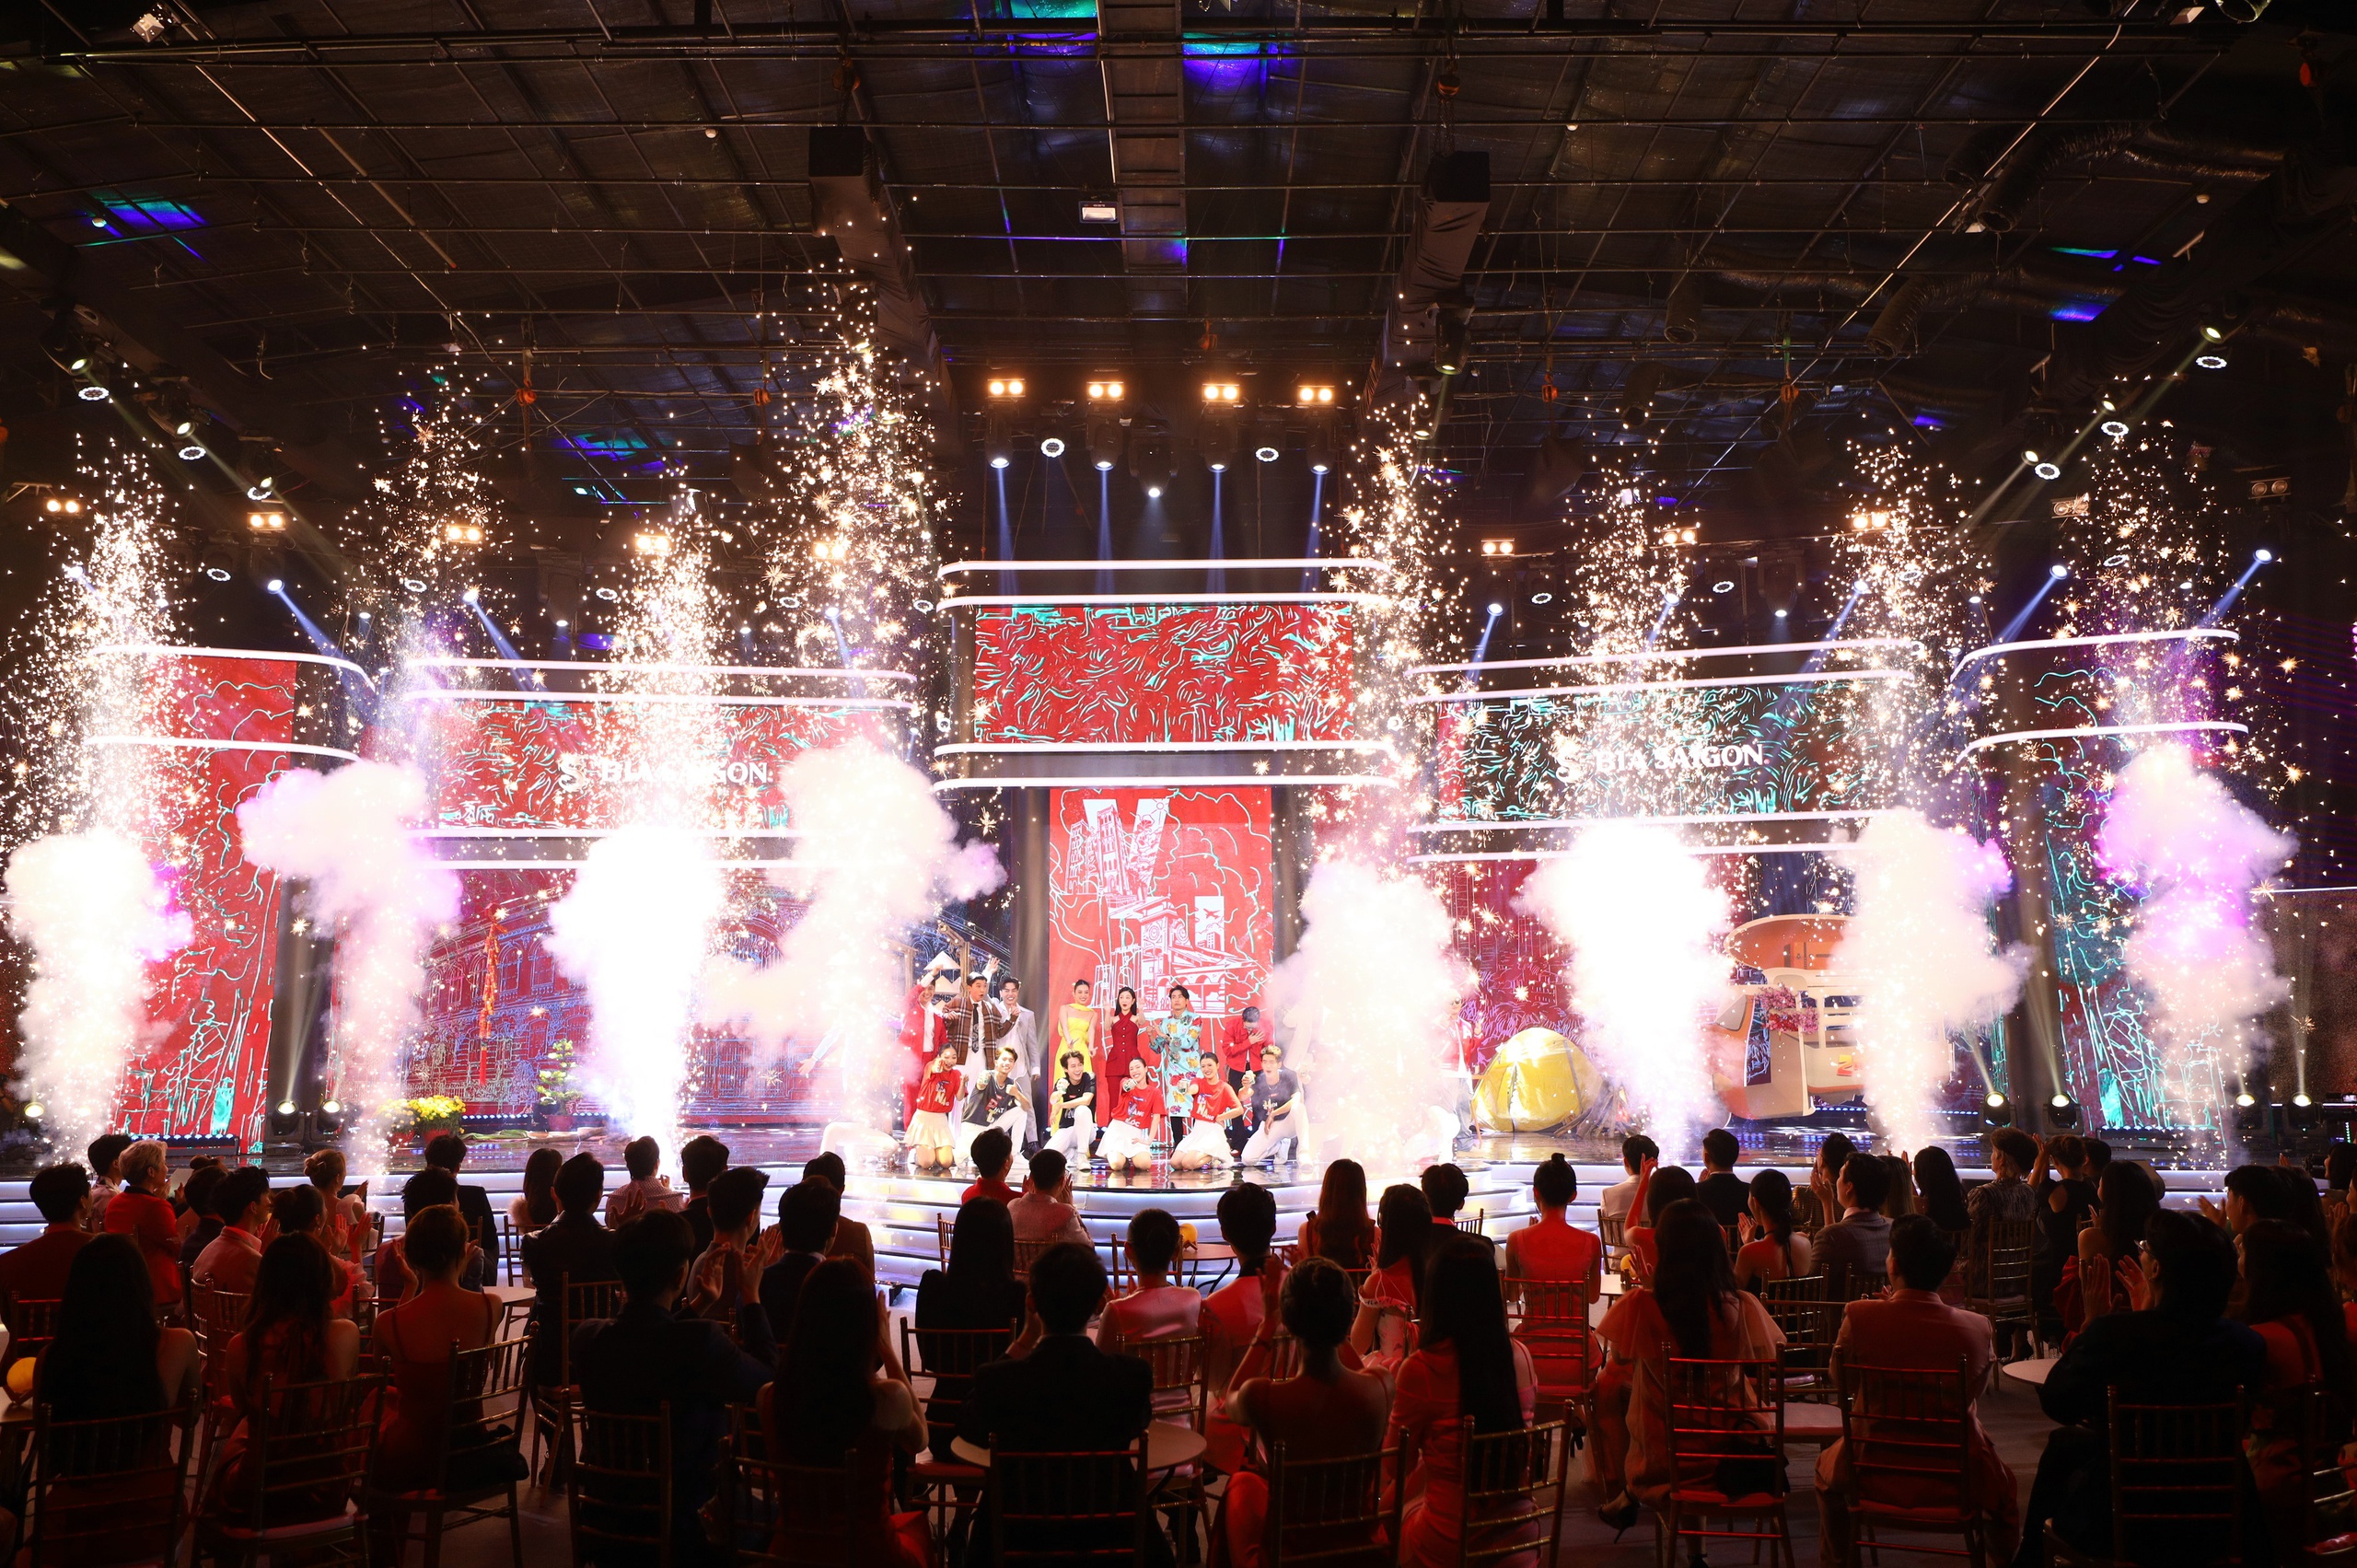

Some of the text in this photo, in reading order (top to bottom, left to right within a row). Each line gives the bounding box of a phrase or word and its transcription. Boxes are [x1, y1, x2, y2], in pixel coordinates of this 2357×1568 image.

[1596, 749, 1649, 772] BIA
[1654, 743, 1763, 770] SAIGON
[659, 761, 768, 784] GON
